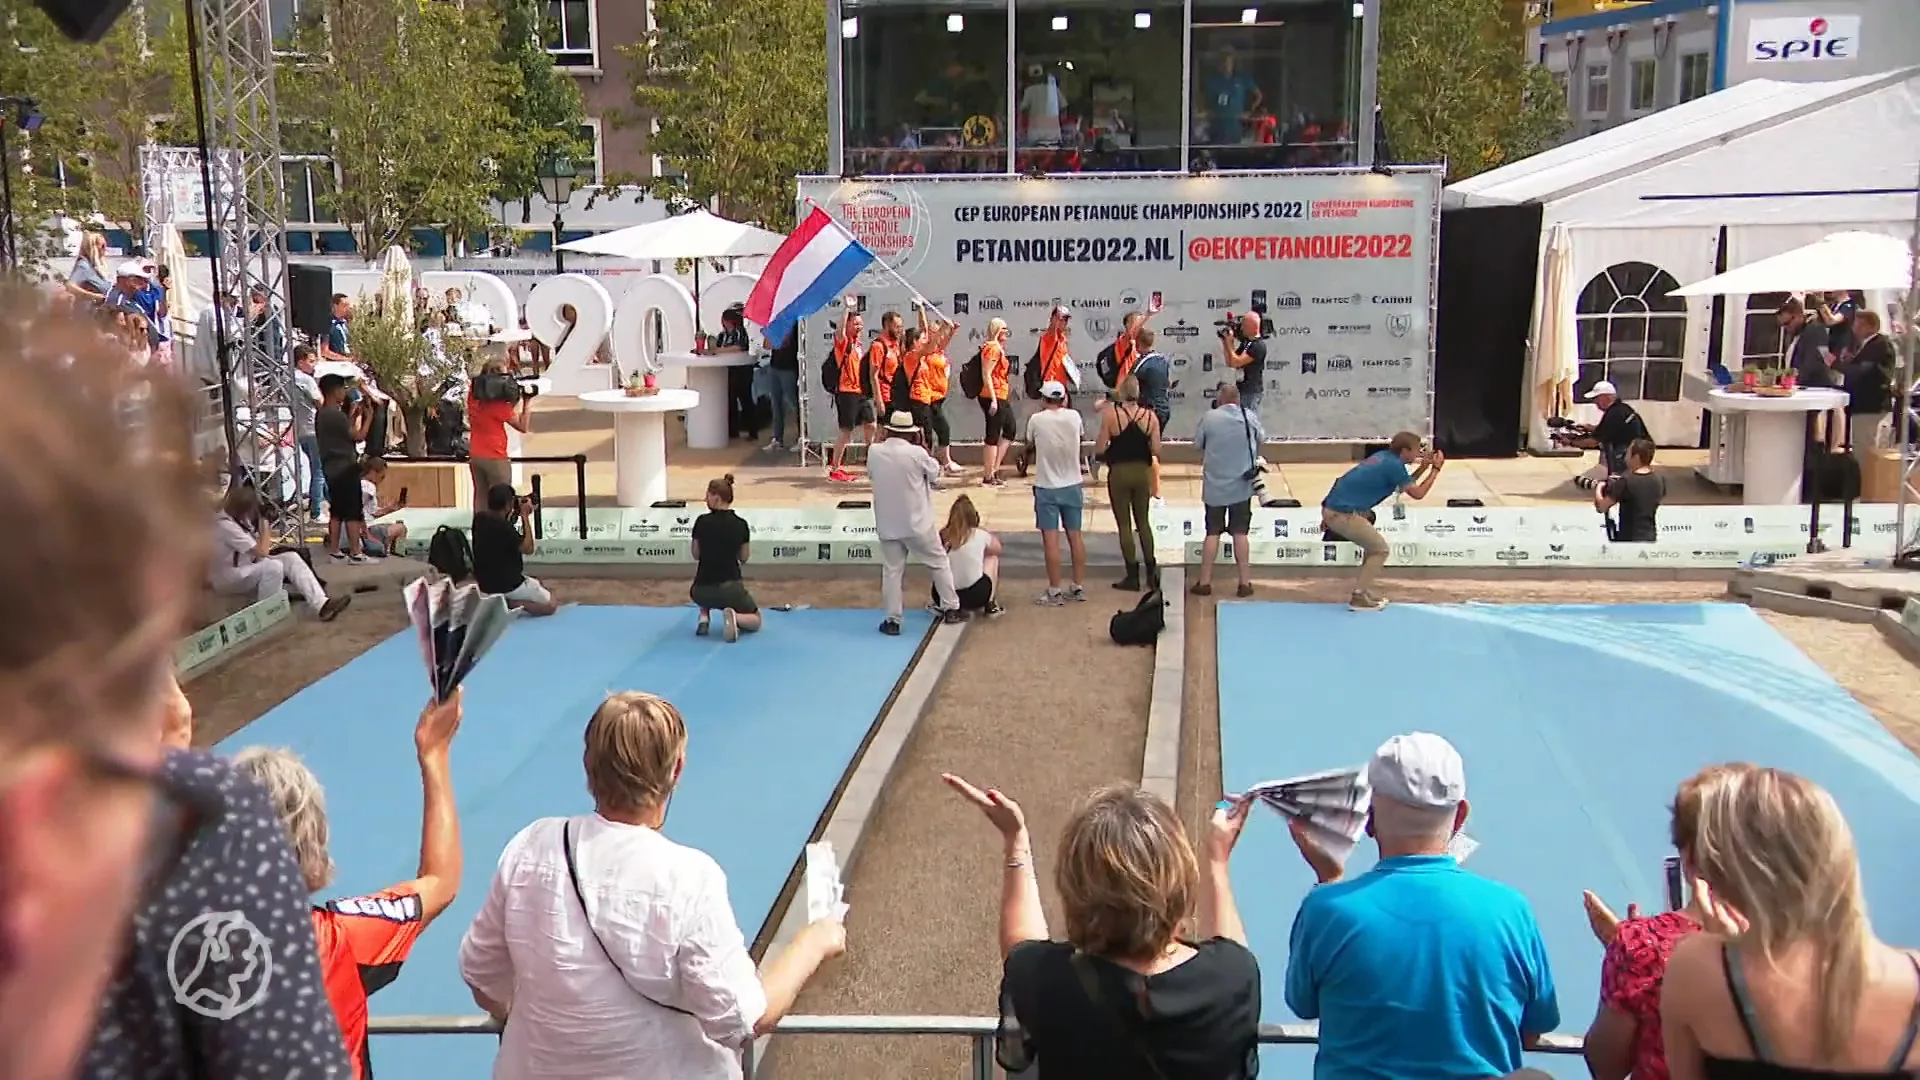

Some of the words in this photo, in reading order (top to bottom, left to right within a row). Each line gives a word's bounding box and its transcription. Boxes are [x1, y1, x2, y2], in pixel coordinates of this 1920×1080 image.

[1755, 18, 1850, 60] SPIE
[842, 204, 858, 220] THE
[862, 206, 911, 220] EUROPEAN
[954, 206, 980, 222] CEP
[983, 205, 1060, 222] EUROPEAN
[1064, 204, 1139, 221] PETANQUE
[1143, 202, 1259, 220] CHAMPIONSHIPS
[1264, 201, 1303, 218] 2022
[859, 234, 914, 248] MPIONSHIPS
[1188, 234, 1412, 262] @EKPETANQUE2022
[956, 238, 1174, 263] PETANQUE2022.NL
[1071, 299, 1111, 308] Canon
[1371, 295, 1412, 304] Canon
[636, 546, 675, 556] Canon
